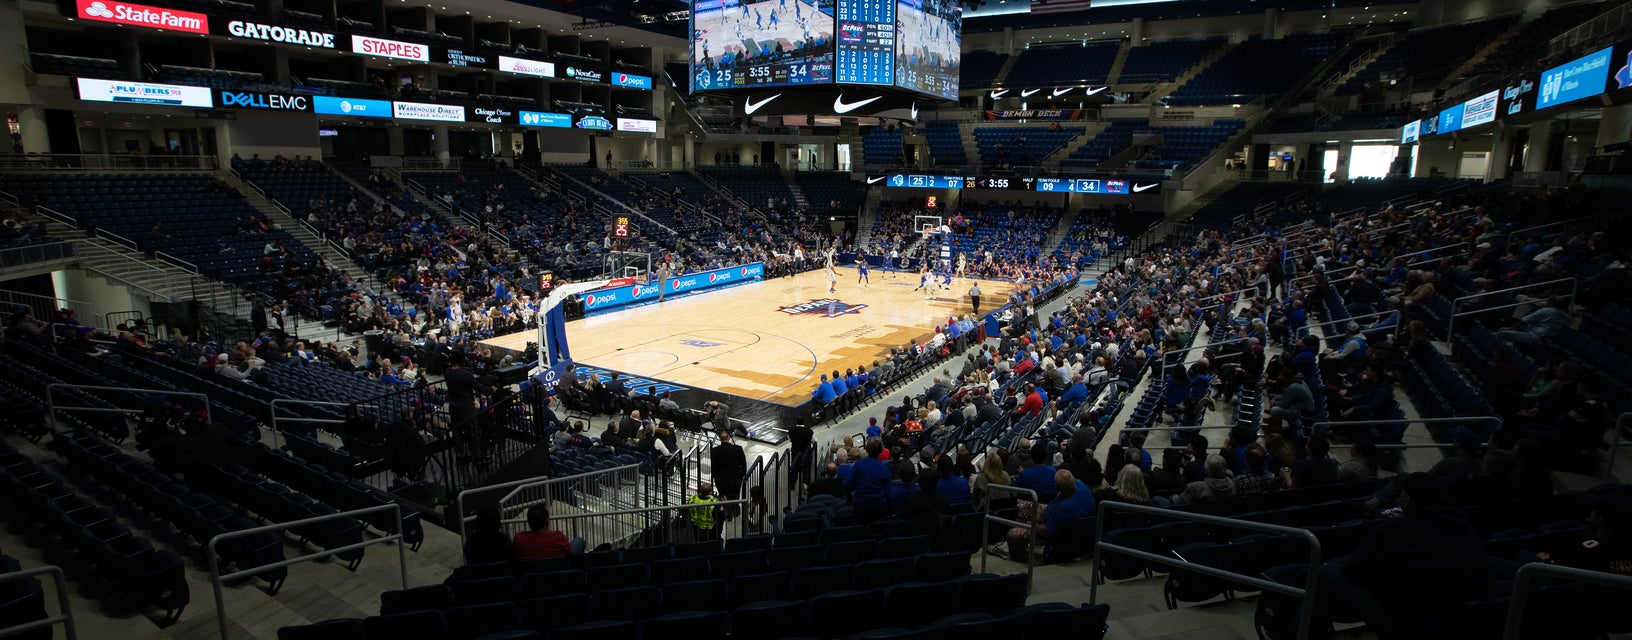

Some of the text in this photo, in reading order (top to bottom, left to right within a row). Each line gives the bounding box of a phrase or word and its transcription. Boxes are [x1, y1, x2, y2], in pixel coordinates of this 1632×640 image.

[115, 5, 200, 29] State Farm
[228, 20, 334, 48] GATORADE
[362, 39, 421, 58] STAPLES
[575, 68, 602, 79] NovaCare
[716, 70, 732, 81] 25
[750, 67, 770, 77] 3:55
[790, 65, 807, 77] 34
[908, 70, 916, 82] 25
[628, 77, 644, 86] pepsi
[222, 92, 307, 110] DELL EMC
[475, 108, 495, 116] Chicago
[948, 180, 958, 188] 07
[989, 179, 1008, 188] 3:55
[1043, 183, 1054, 191] 09
[1082, 182, 1094, 191] 34
[616, 225, 627, 236] 25
[716, 272, 730, 280] pepsi
[747, 266, 760, 275] pepsi
[542, 281, 550, 289] 25
[681, 278, 696, 287] pepsi
[642, 285, 659, 296] pepsi
[597, 293, 616, 305] pepsi
